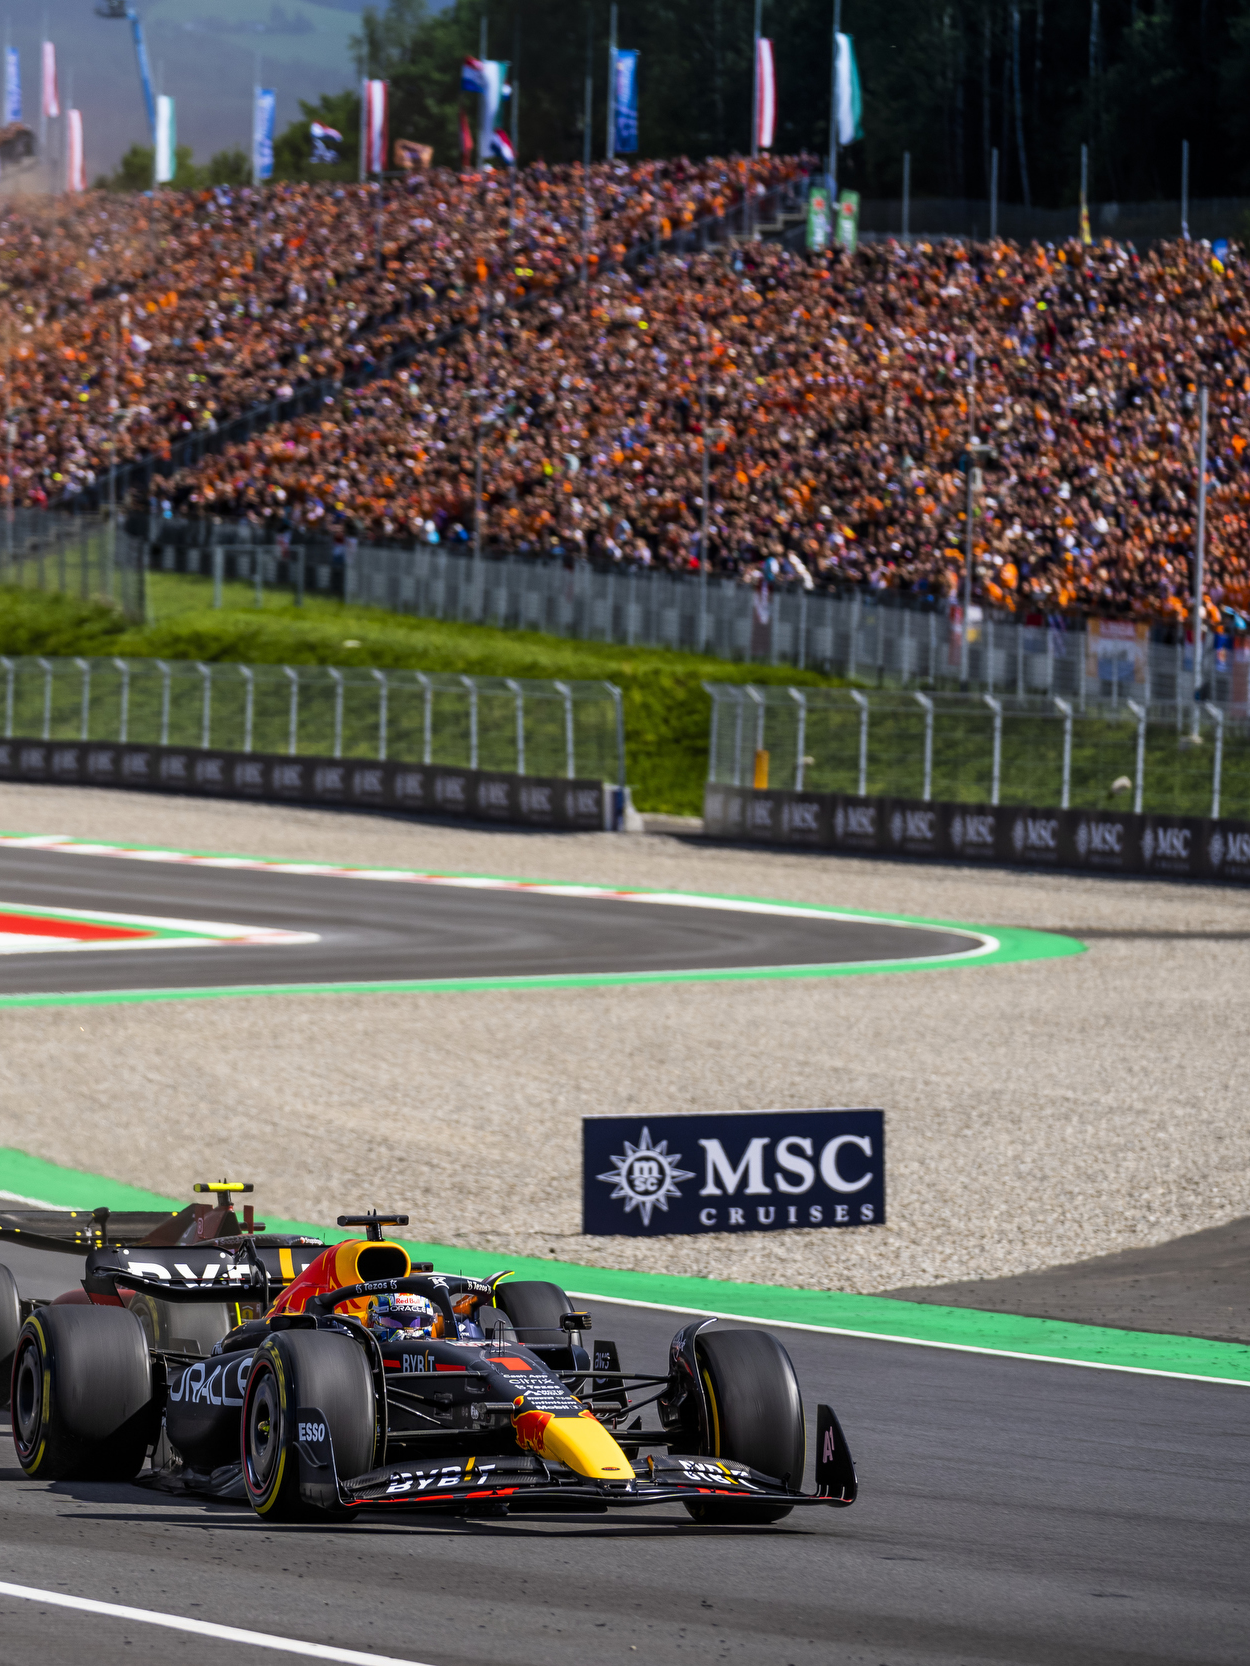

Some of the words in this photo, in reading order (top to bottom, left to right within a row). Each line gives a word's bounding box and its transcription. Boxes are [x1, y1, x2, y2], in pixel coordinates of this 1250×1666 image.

[1226, 831, 1250, 863] MS
[698, 1134, 874, 1196] MSC
[699, 1203, 875, 1226] CRUISES
[364, 1281, 388, 1291] Tezos
[402, 1350, 435, 1373] BYBIT
[298, 1422, 326, 1442] ESSO
[386, 1456, 496, 1493] BYBIT
